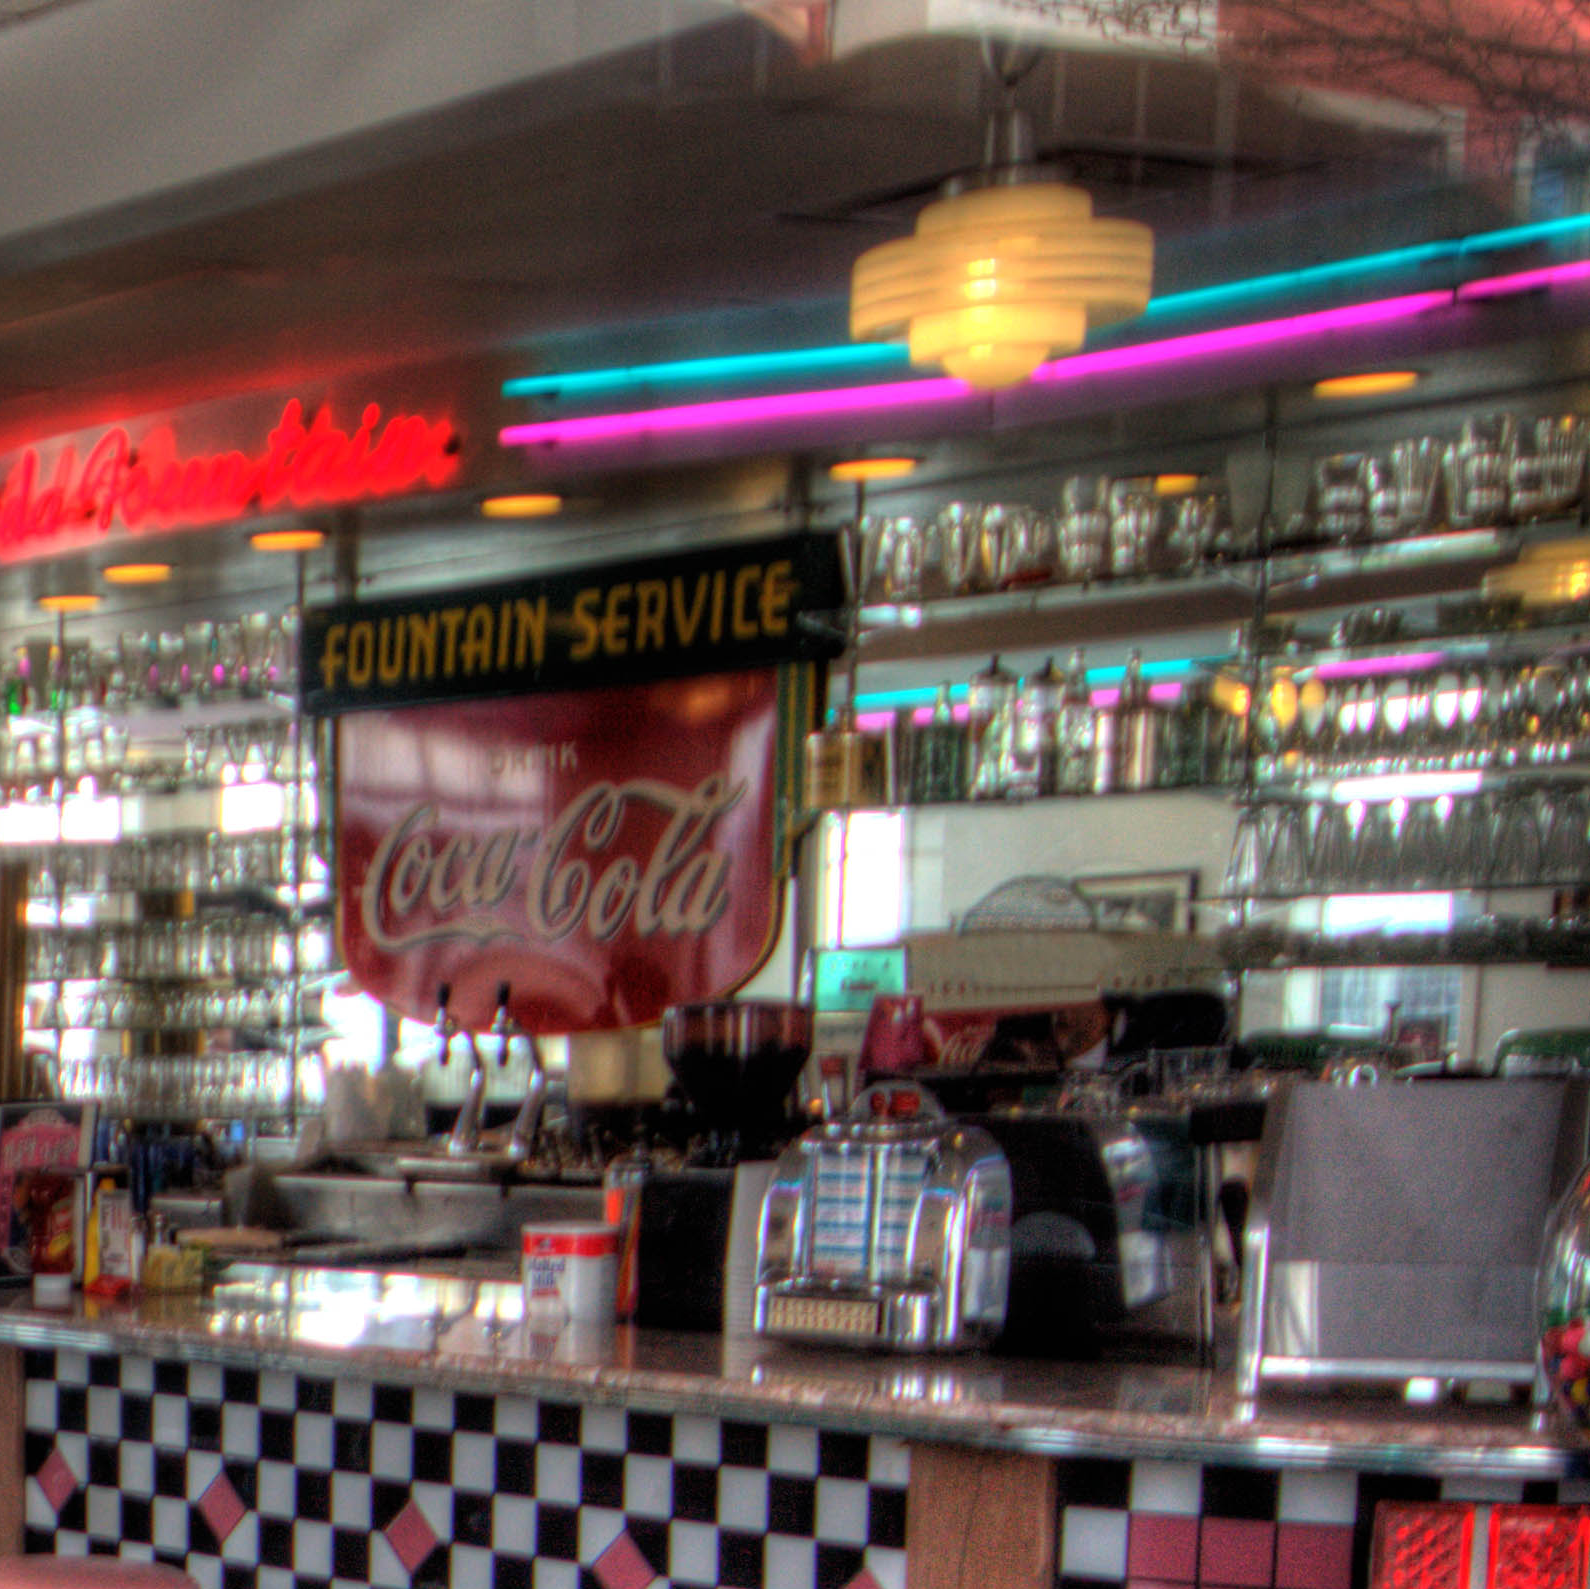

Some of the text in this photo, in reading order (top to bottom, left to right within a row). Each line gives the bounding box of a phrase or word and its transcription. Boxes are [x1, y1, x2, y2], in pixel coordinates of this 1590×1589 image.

[82, 398, 458, 535] Fountain
[320, 560, 800, 690] FOUNTAIN SERVICE
[361, 772, 748, 953] Coca-Cola
